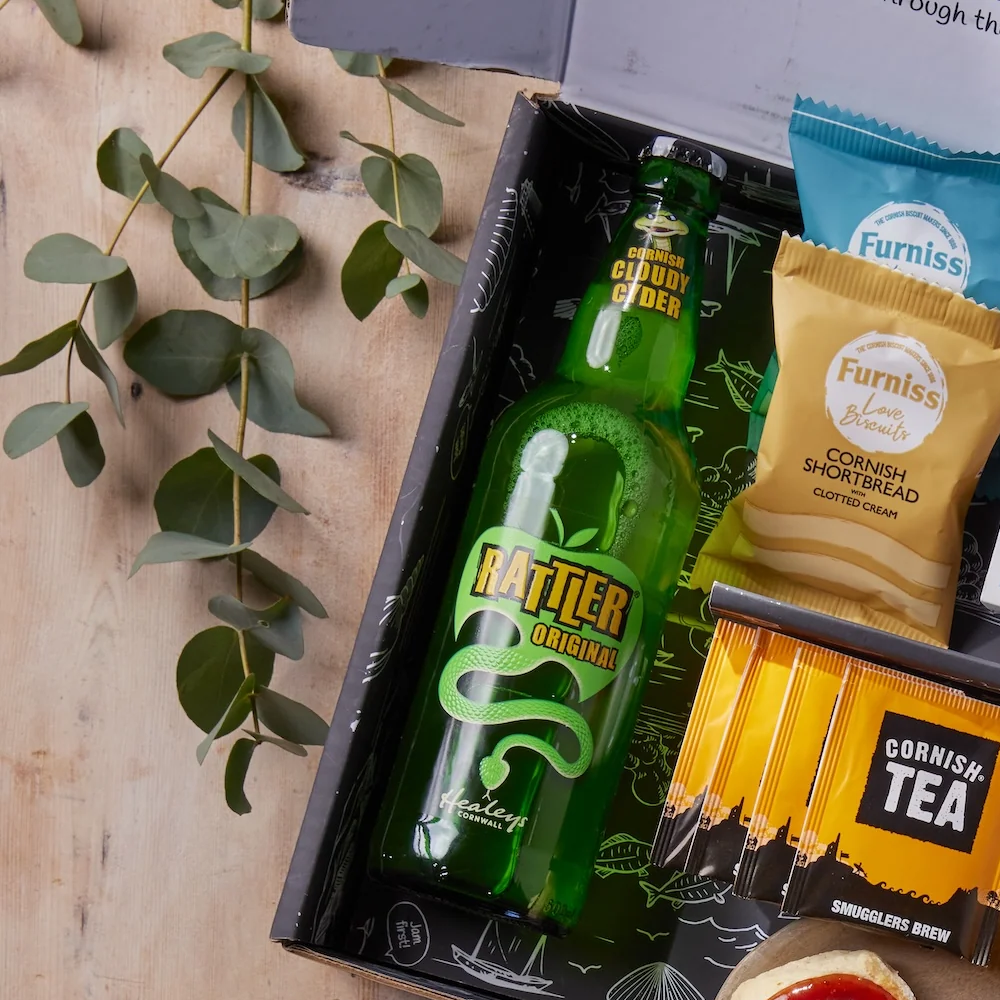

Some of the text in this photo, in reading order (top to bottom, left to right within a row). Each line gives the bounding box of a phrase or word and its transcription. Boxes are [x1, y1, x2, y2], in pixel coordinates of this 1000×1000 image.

[628, 246, 685, 270] CORNISH
[858, 231, 964, 277] Furniss
[611, 260, 690, 295] CLOUDY
[612, 283, 682, 320] CYDER
[837, 356, 941, 410] Furniss
[839, 403, 911, 442] Biscuits
[862, 392, 905, 421] Love
[803, 457, 919, 504] SHORTBREAD
[826, 447, 907, 483] CORNISH
[813, 487, 898, 520] CLOTTED CREAM
[851, 488, 866, 498] WITH
[472, 544, 632, 640] RATTLER
[531, 624, 619, 672] ORIGINAL
[885, 738, 984, 782] CORNISH
[439, 787, 528, 833] Healeys
[884, 761, 968, 832] TEA
[458, 811, 503, 830] CORNWALL
[395, 919, 412, 948] first!
[410, 921, 422, 945] Jam
[831, 899, 952, 944] SMUGGLERS BREW
